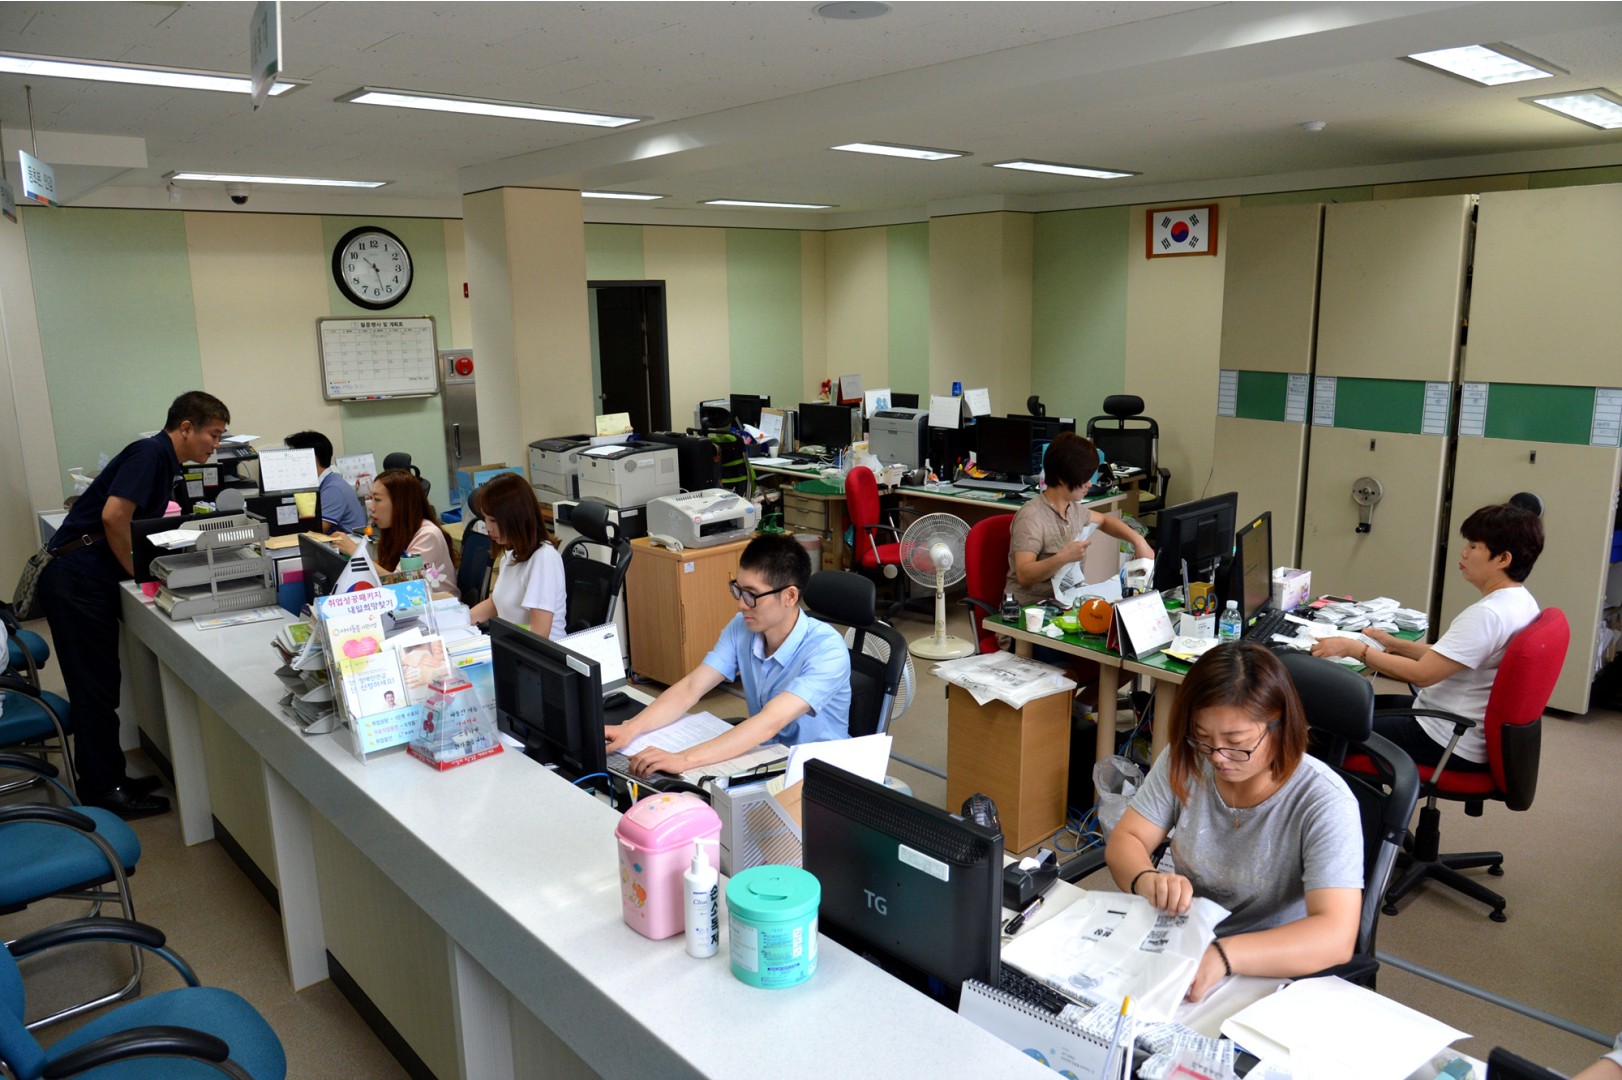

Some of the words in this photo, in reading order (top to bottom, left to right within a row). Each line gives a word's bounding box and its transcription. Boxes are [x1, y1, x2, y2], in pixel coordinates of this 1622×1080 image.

[359, 242, 366, 251] 11
[369, 240, 379, 248] 12
[384, 243, 388, 252] 1
[350, 251, 359, 260] 10
[391, 252, 399, 261] 2
[348, 263, 355, 272] 9
[395, 264, 402, 272] 3
[353, 276, 360, 285] 8
[392, 275, 399, 284] 4
[361, 285, 369, 294] 7
[373, 287, 380, 296] 6
[385, 285, 393, 293] 5
[328, 591, 382, 608] 취업성공패키지
[348, 599, 394, 614] 내일희망찾기
[863, 888, 888, 916] TG
